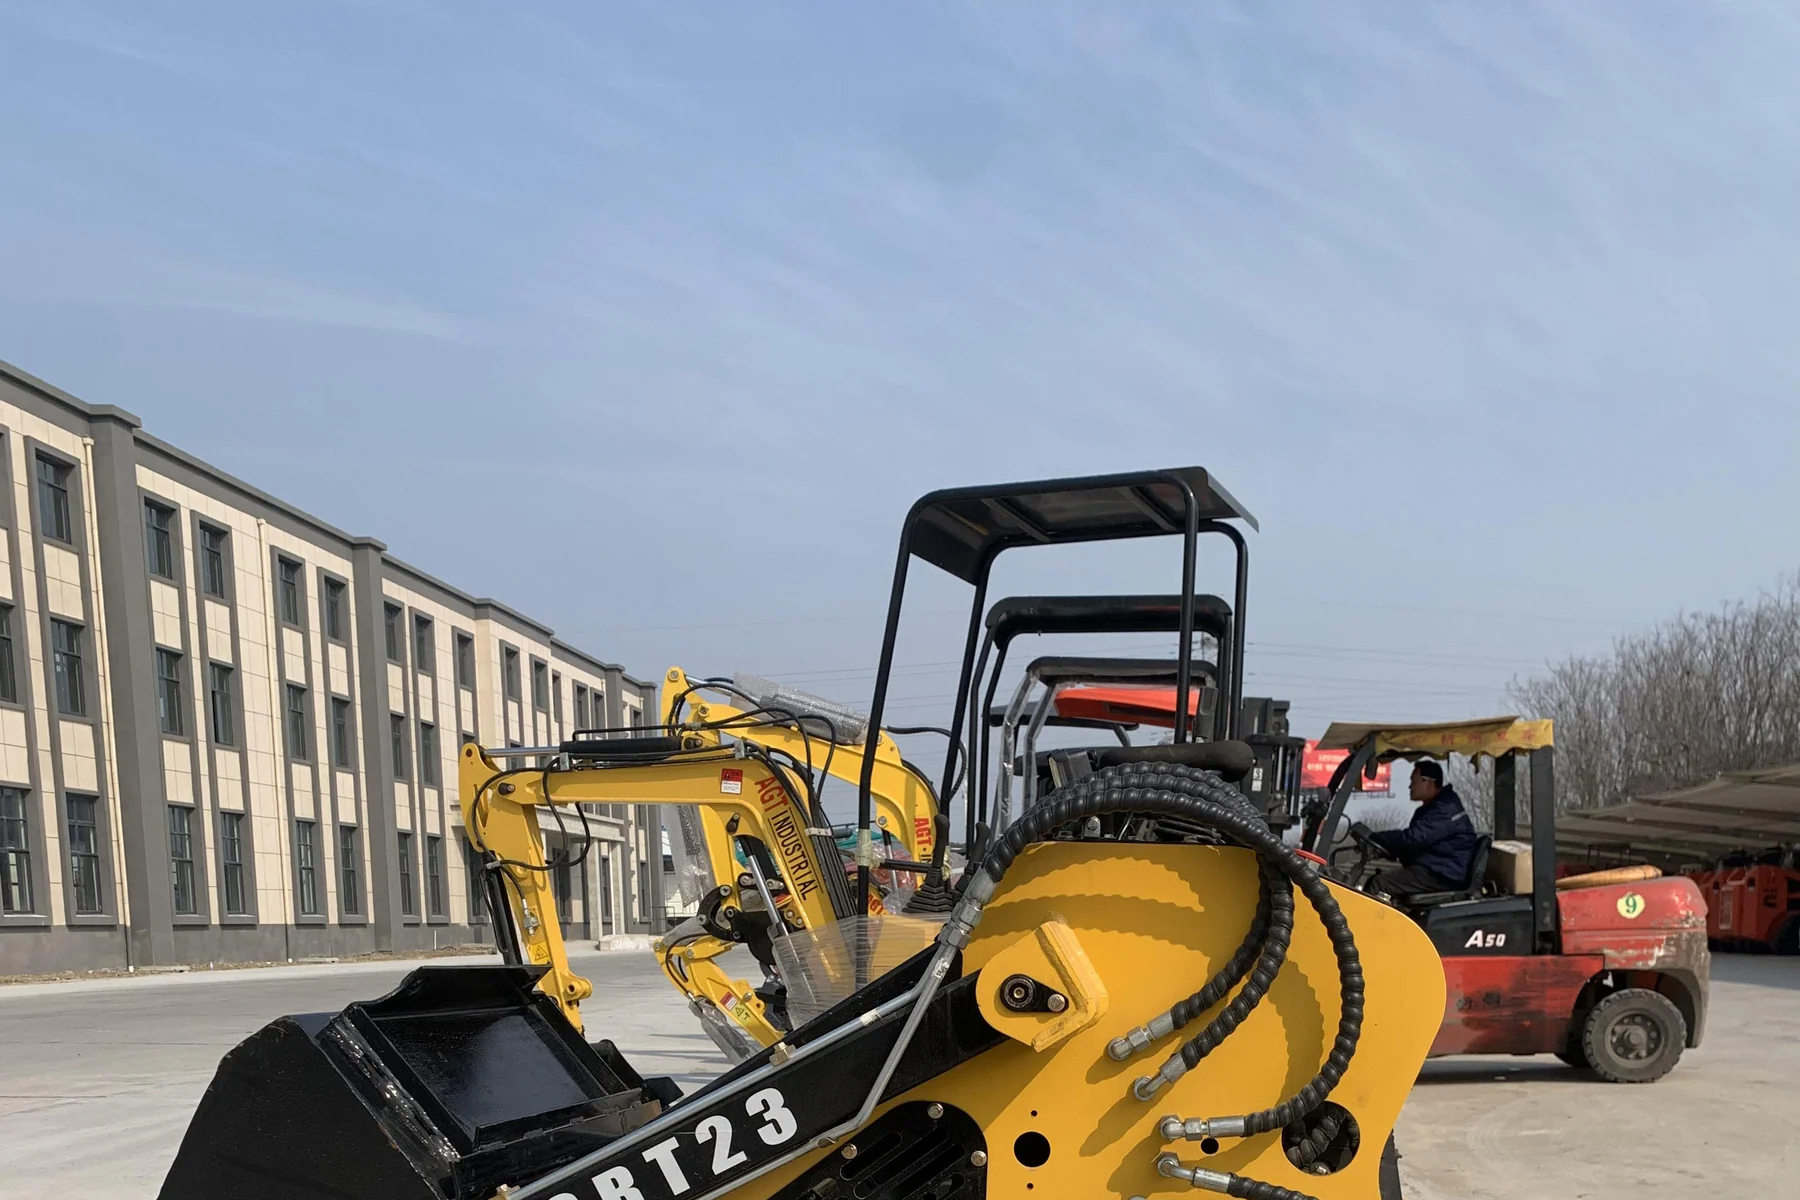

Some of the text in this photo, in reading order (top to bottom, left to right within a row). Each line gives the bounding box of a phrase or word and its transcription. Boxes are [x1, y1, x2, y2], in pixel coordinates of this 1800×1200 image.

[755, 776, 819, 901] AGT INDUSTRIAL
[913, 817, 933, 846] AGT
[1625, 894, 1637, 914] 9
[1464, 929, 1507, 948] A50
